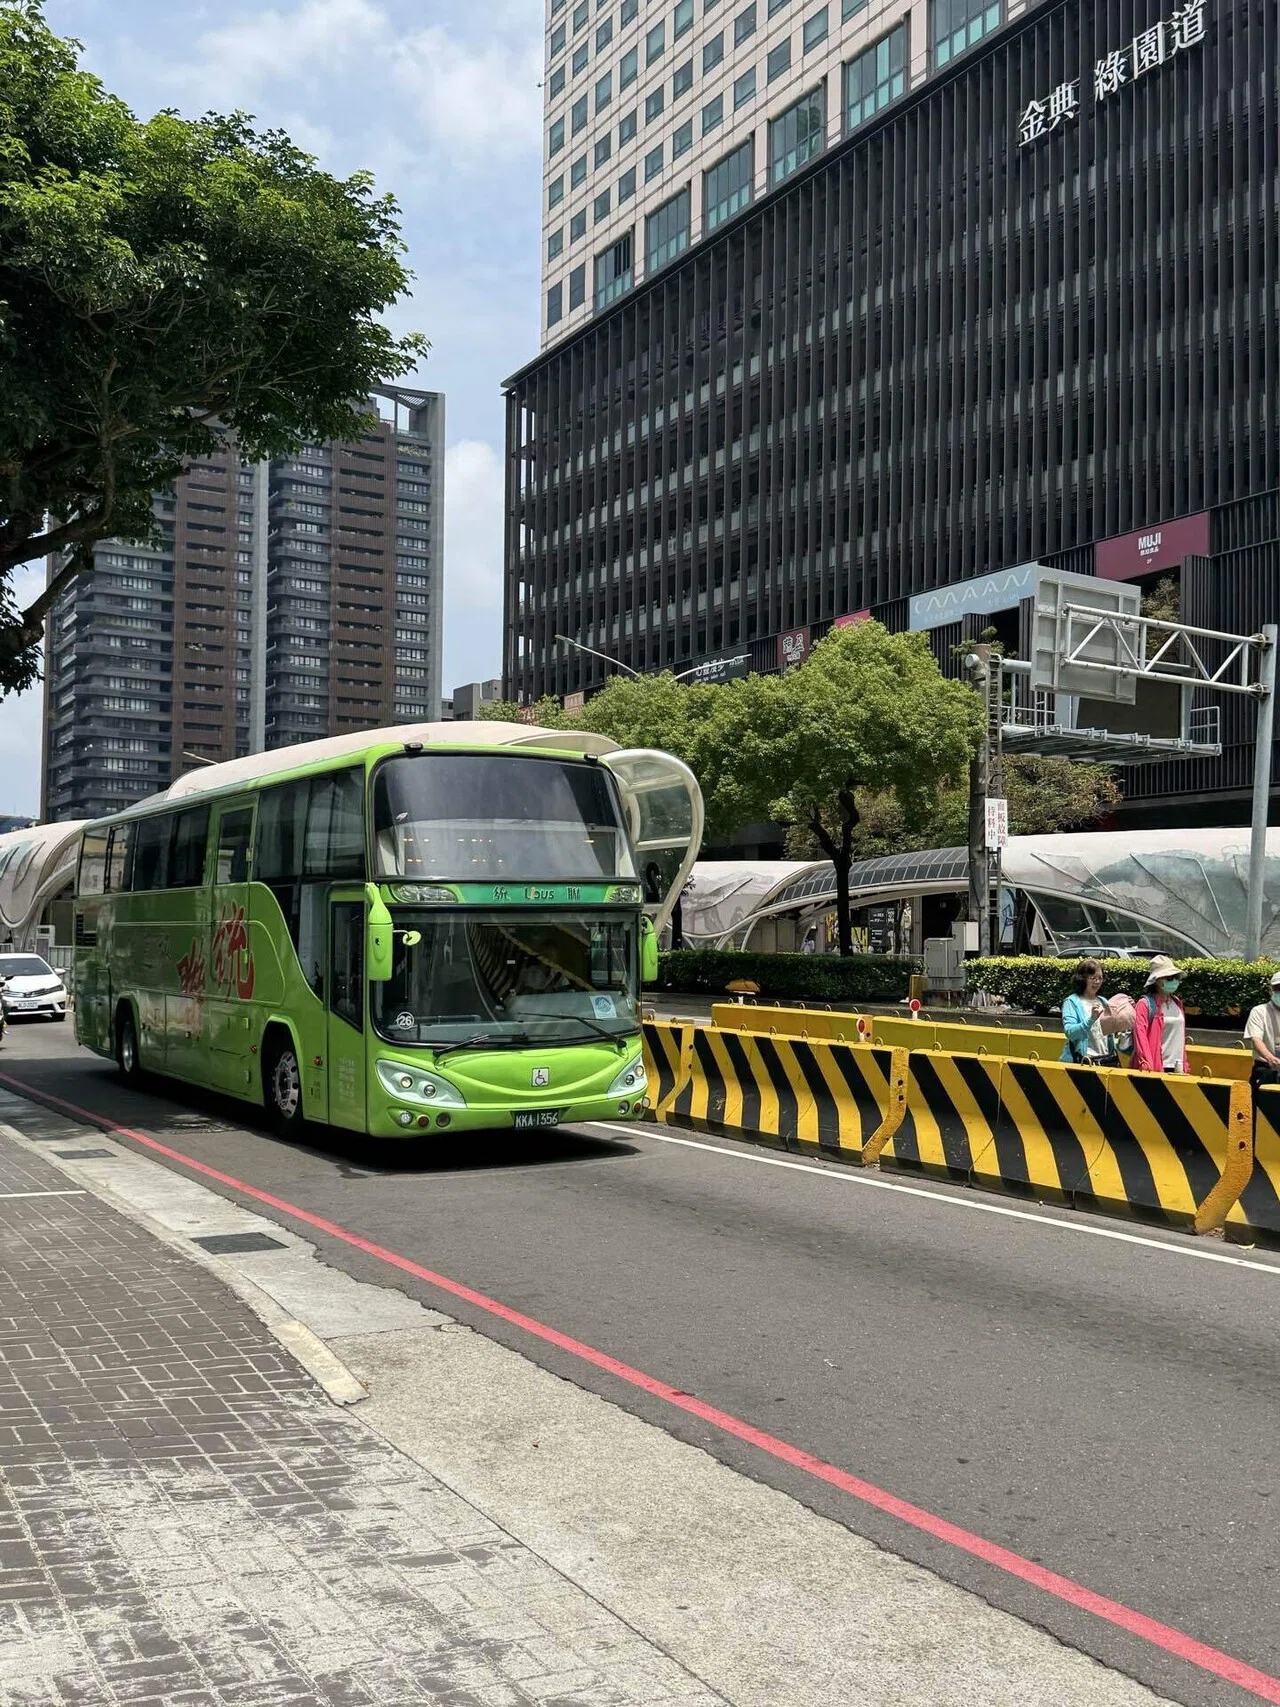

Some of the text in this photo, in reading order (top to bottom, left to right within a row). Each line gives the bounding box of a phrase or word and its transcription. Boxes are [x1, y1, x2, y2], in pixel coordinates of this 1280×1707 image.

[1018, 0, 1208, 147] 金典 綠園道
[1138, 532, 1161, 550] MUJI
[398, 1014, 412, 1027] 26
